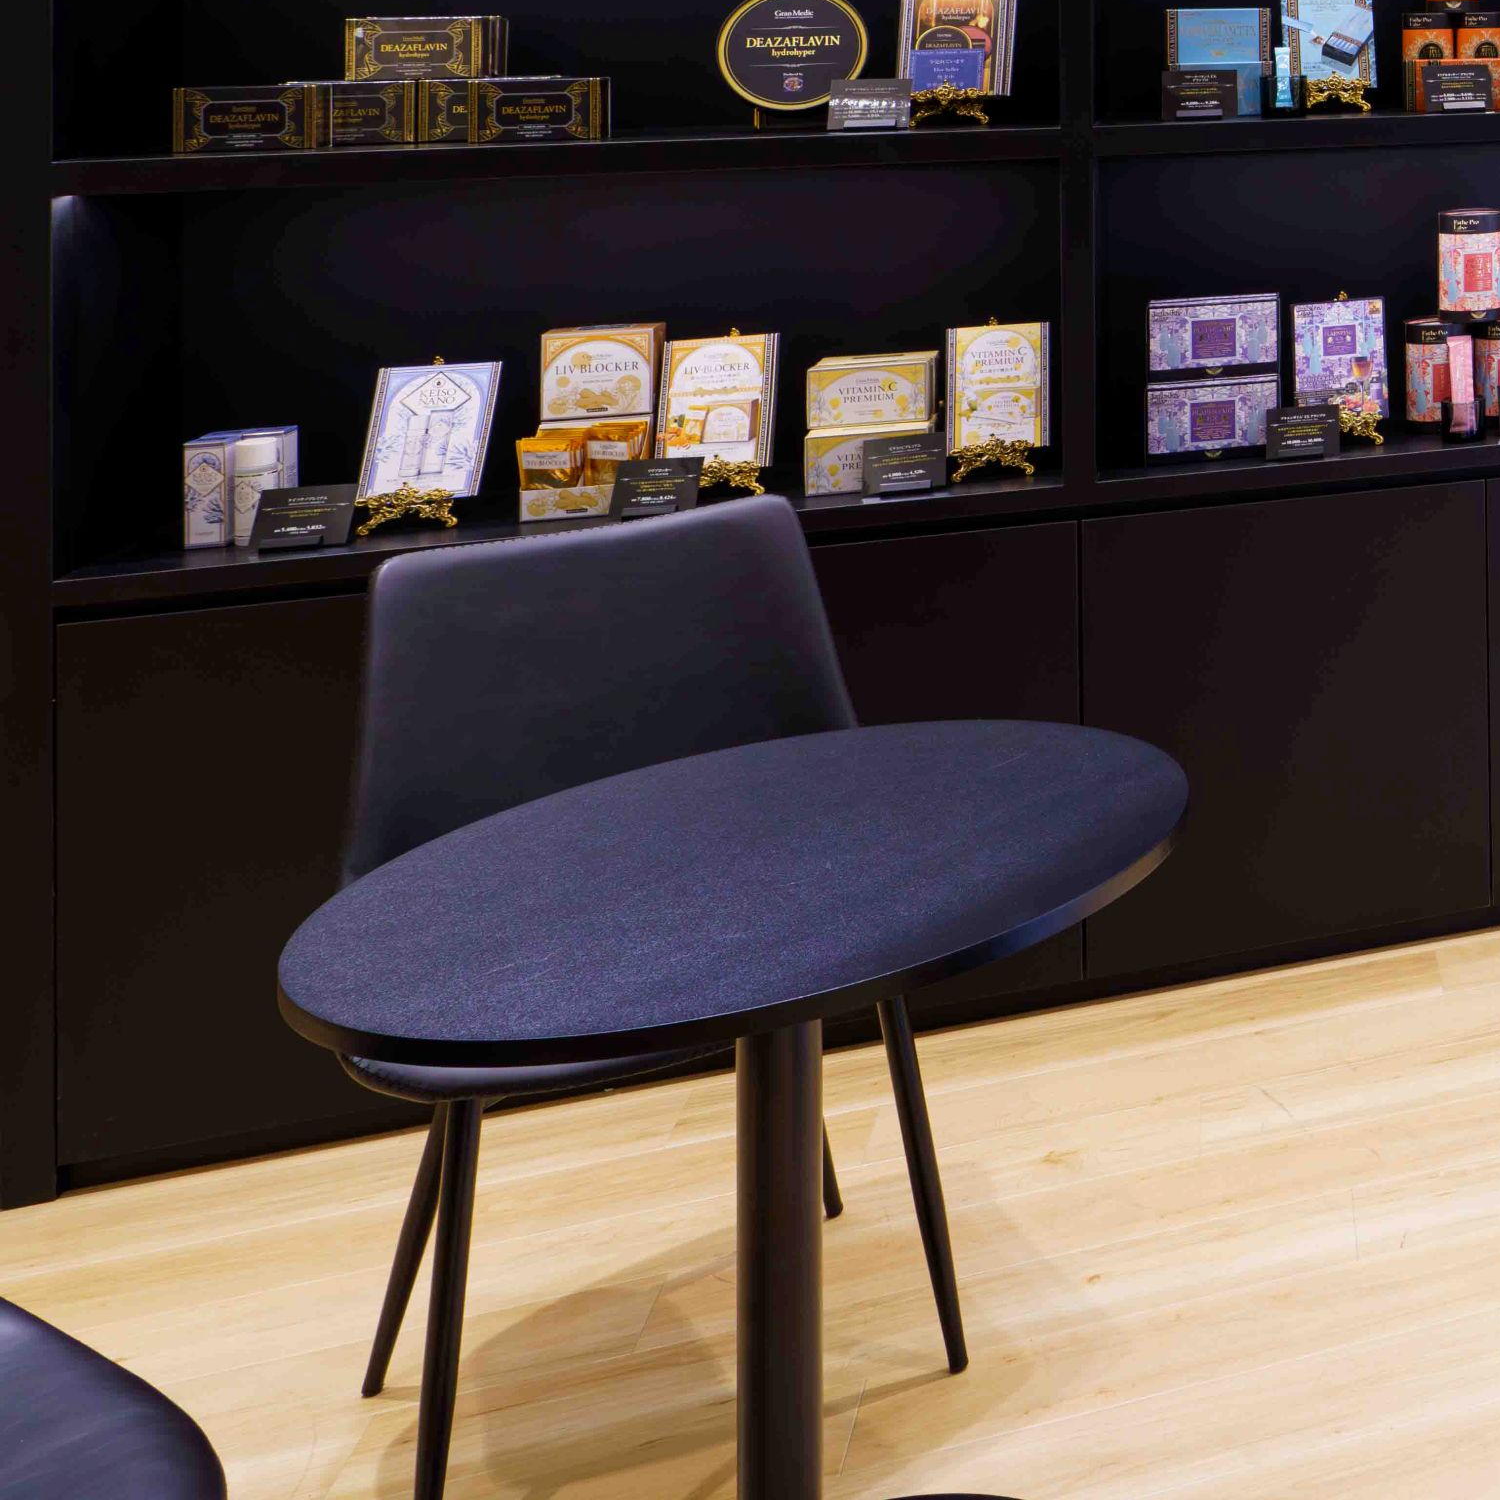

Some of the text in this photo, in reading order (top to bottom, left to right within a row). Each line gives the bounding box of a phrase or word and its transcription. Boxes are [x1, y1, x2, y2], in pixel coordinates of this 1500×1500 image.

[774, 9, 814, 18] Gran Medic
[746, 35, 840, 48] DEAZAFLAVIN
[380, 43, 448, 52] DEAZAFLAVIN
[772, 48, 815, 58] hydrohyper
[502, 105, 566, 115] DEAZAFLAVIN
[209, 114, 279, 124] DEAZAFLAVIN
[971, 350, 1016, 359] VITAMIN
[975, 357, 1024, 367] PREMIUM
[555, 362, 640, 375] LIV BLOCKER
[419, 388, 457, 398] KEISO
[839, 385, 883, 396] VITAMIN
[419, 396, 456, 406] NANO
[843, 393, 894, 404] PREMIUM
